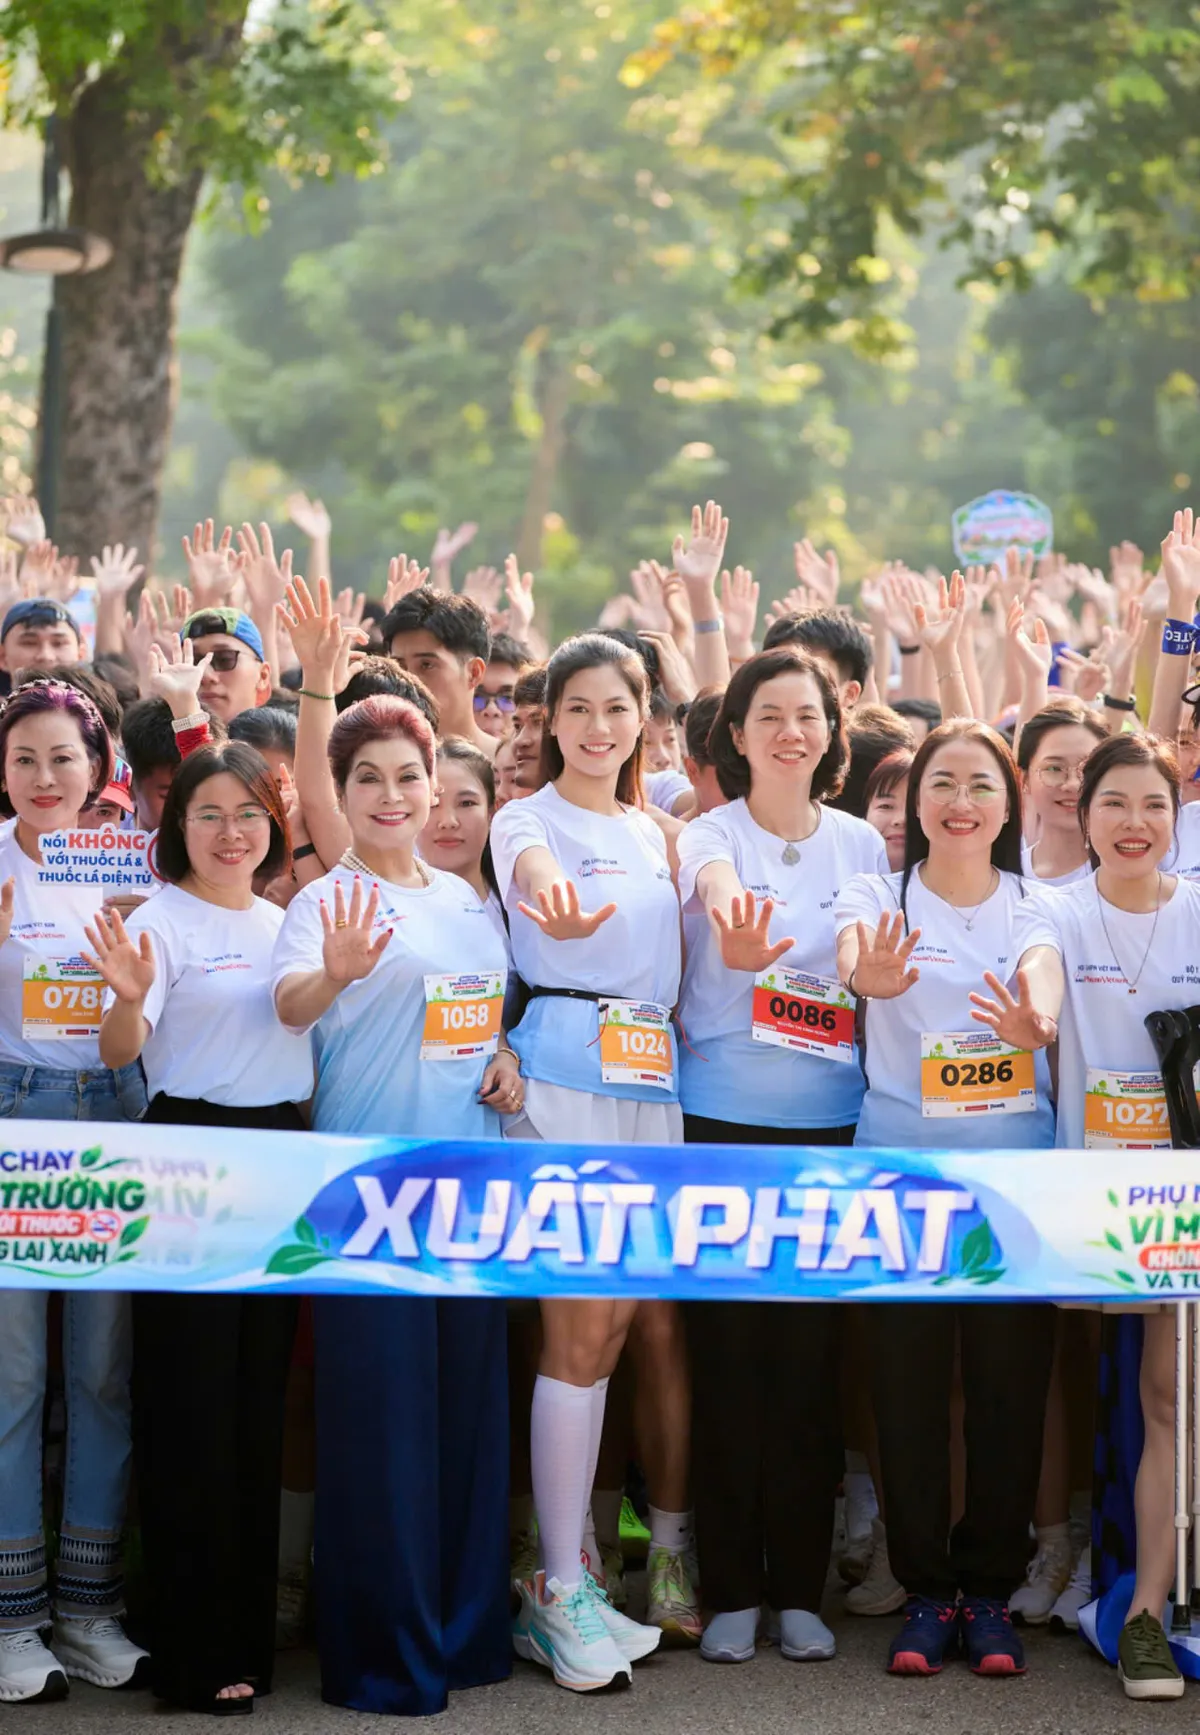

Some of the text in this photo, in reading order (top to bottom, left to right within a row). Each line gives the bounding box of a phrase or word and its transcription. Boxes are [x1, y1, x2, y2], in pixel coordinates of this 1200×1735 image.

[43, 827, 146, 850] NÓI KHÔNG
[47, 850, 143, 866] VỚI THUỐC LÁ &
[38, 866, 153, 886] THUỐC LÁ ĐIỆN TỬ
[441, 1003, 489, 1030] 1058
[769, 996, 836, 1031] 0086
[617, 1031, 667, 1057] 1024
[941, 1060, 1013, 1086] 0286
[0, 1150, 75, 1177] CHẠY
[0, 1172, 146, 1212] TRƯỜNG
[1129, 1185, 1186, 1210] PHỤ
[341, 1160, 977, 1272] XUẤT PHÁT
[13, 1241, 44, 1261] LAI
[49, 1238, 108, 1263] XANH
